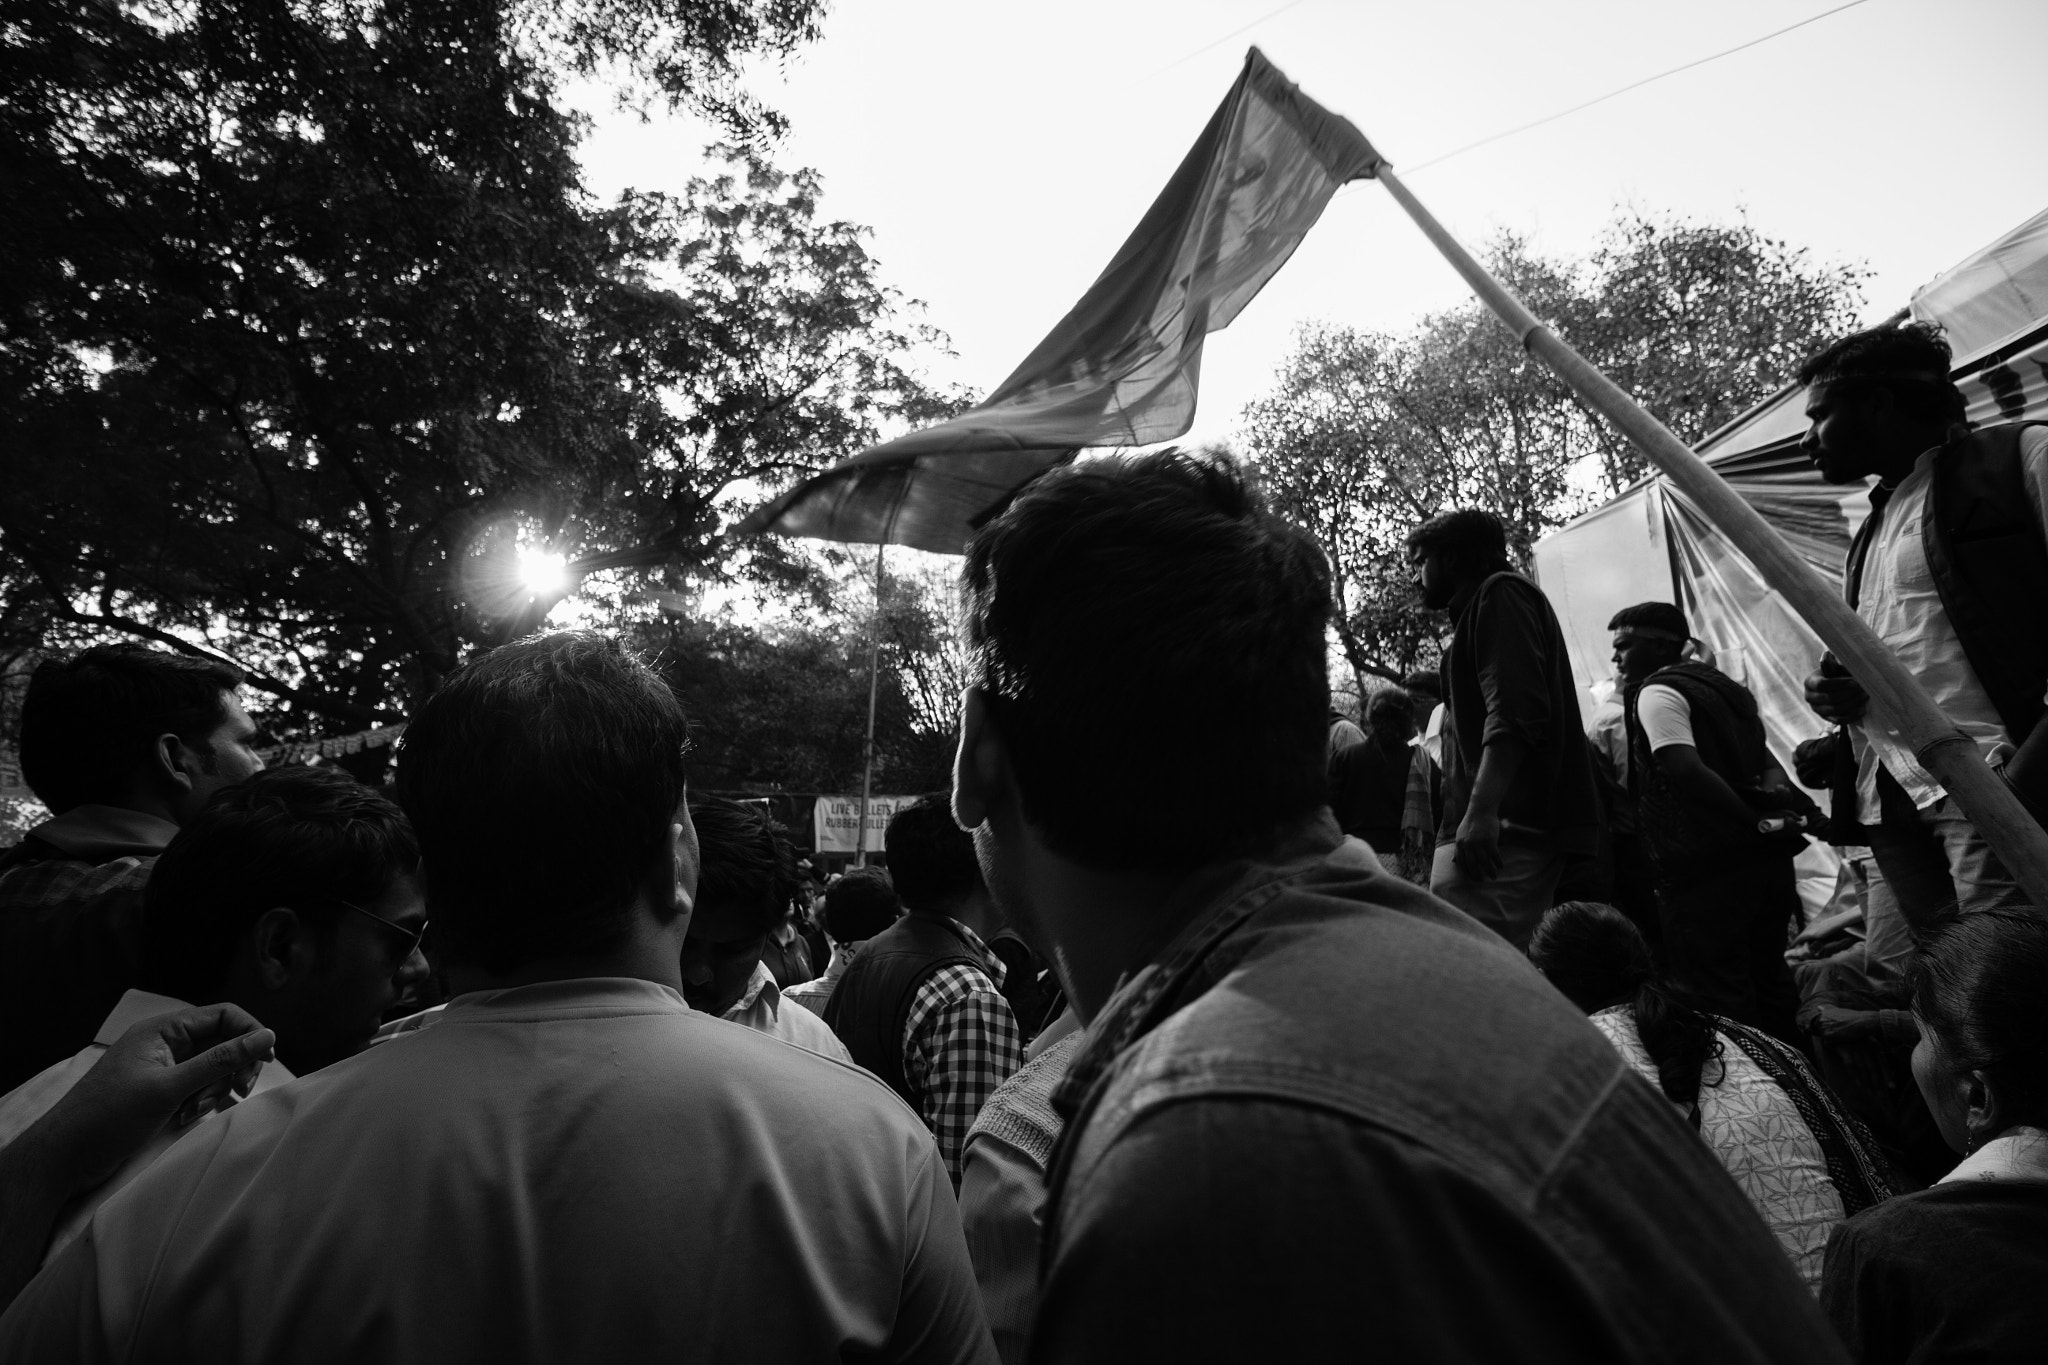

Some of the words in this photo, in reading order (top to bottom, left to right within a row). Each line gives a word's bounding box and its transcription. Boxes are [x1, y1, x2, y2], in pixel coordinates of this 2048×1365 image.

[831, 803, 850, 815] LIVE
[854, 804, 892, 816] BLLETS
[825, 818, 858, 829] RUBBER
